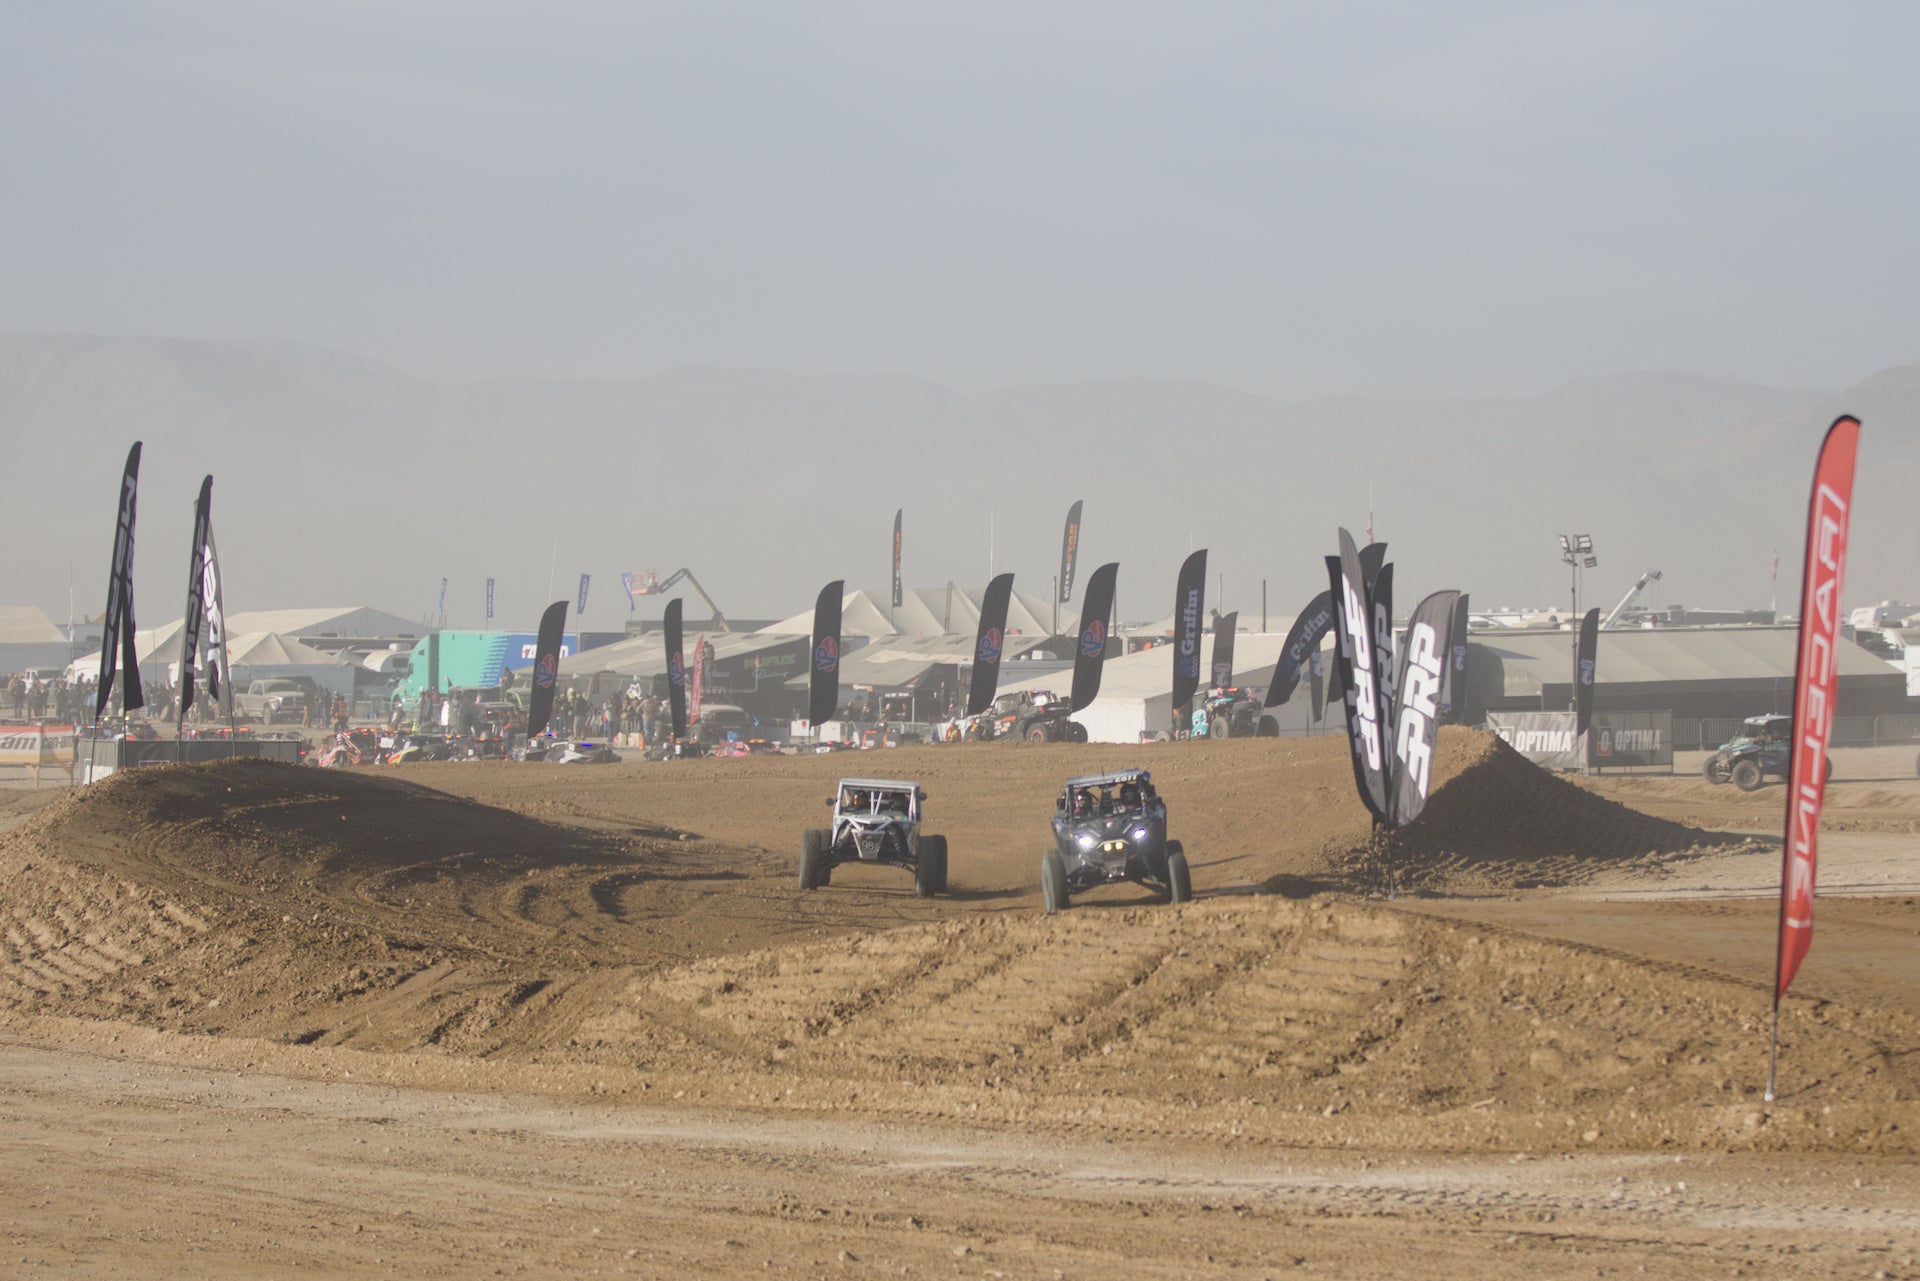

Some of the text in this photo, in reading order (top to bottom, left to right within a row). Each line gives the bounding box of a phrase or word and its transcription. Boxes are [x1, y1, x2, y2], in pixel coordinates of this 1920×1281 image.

[1181, 589, 1199, 656] Griffin
[1397, 622, 1443, 799] PRP
[1515, 730, 1572, 752] OPTIMA
[1614, 729, 1661, 751] OPTIMA
